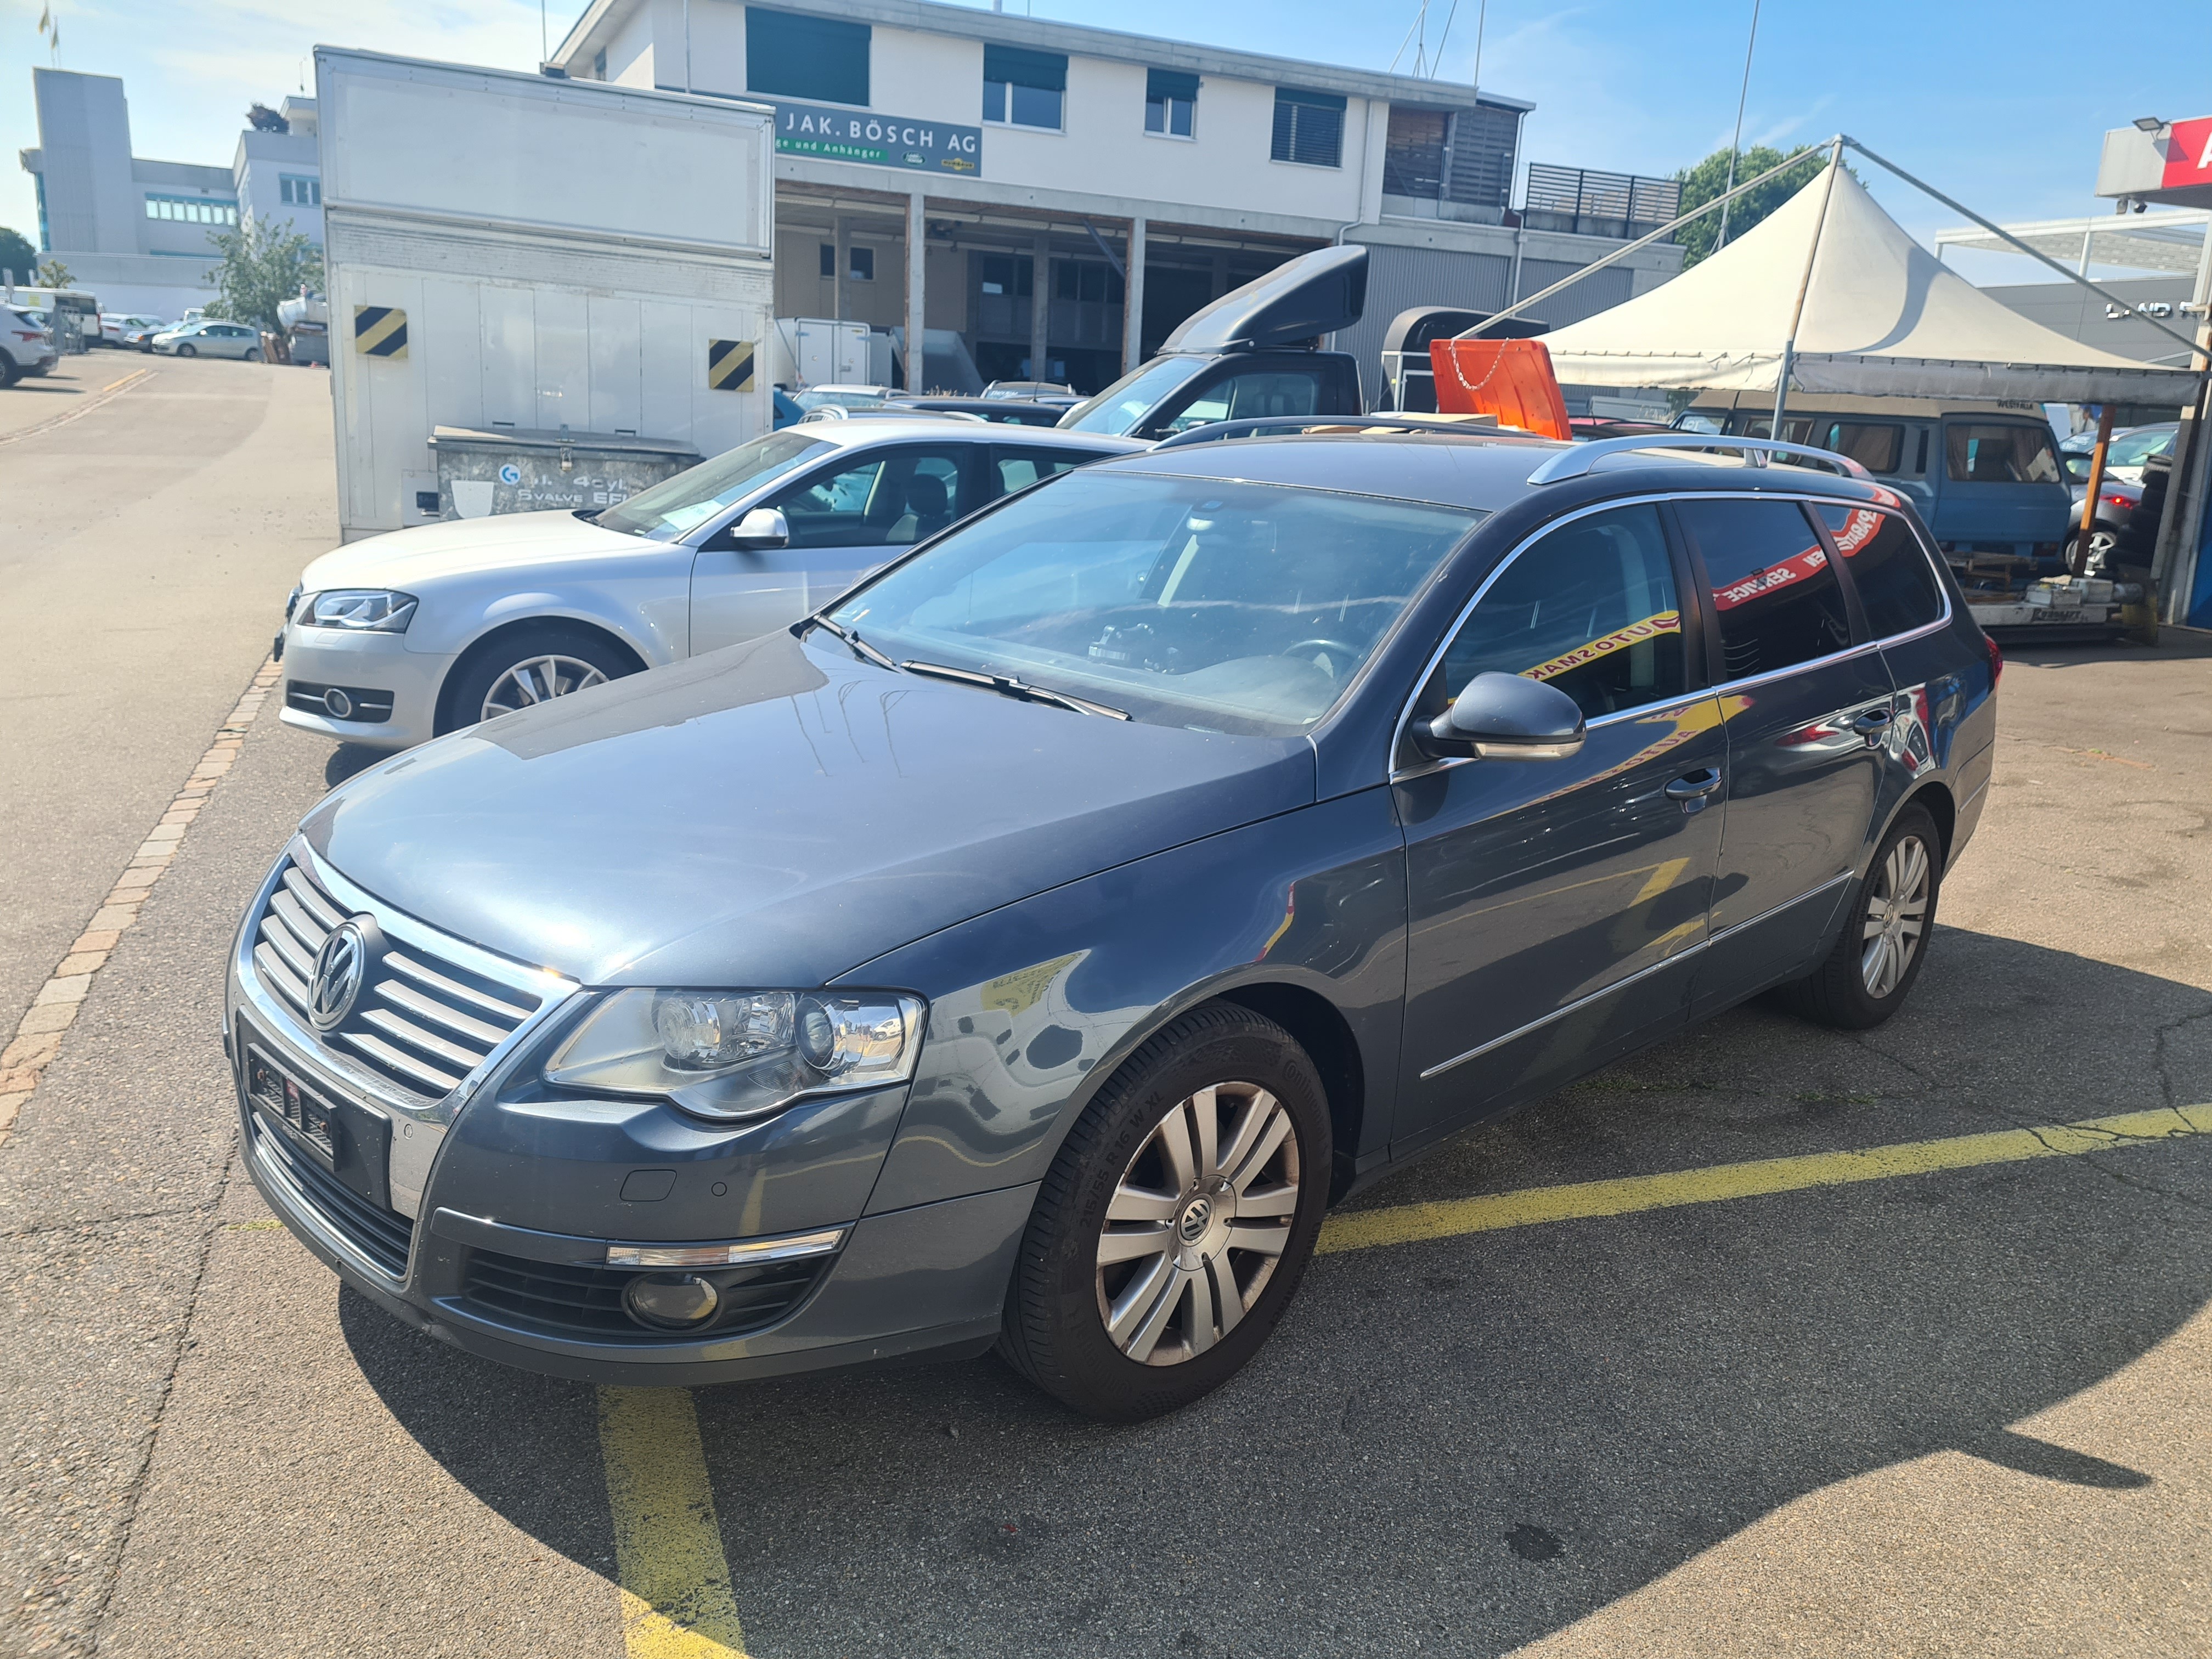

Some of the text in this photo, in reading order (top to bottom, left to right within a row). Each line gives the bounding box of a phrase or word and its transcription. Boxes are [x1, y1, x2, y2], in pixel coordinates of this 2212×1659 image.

[786, 112, 976, 153] JAK. BÖSCH AG
[795, 140, 817, 151] und
[823, 143, 881, 159] Anhänger
[2105, 302, 2171, 318] LND
[1105, 1152, 1119, 1166] R
[1115, 1130, 1131, 1149] 16
[1129, 1108, 1145, 1128] W
